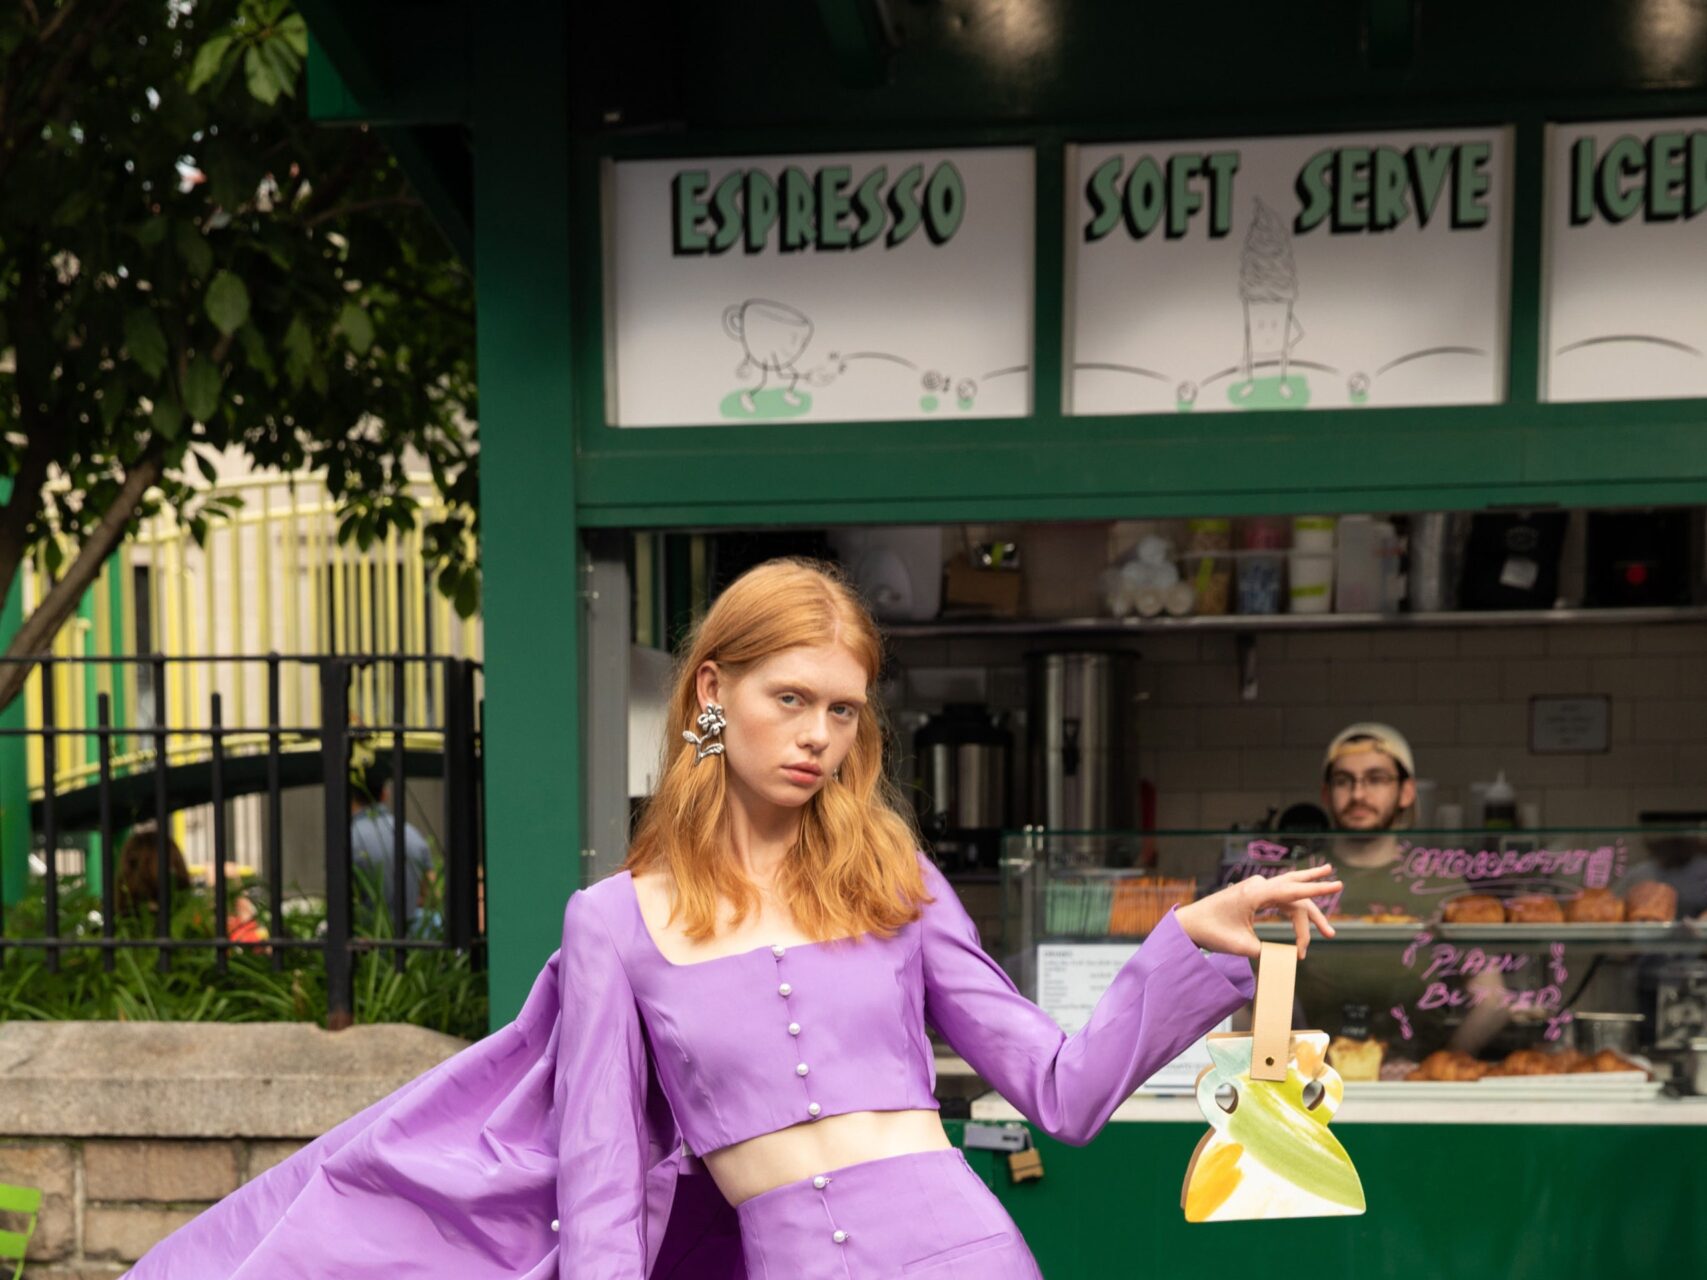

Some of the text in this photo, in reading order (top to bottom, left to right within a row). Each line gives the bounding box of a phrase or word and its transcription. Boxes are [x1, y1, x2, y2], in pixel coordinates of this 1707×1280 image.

[671, 159, 966, 256] ESPRESSO
[1084, 141, 1492, 242] SOFT SERVE
